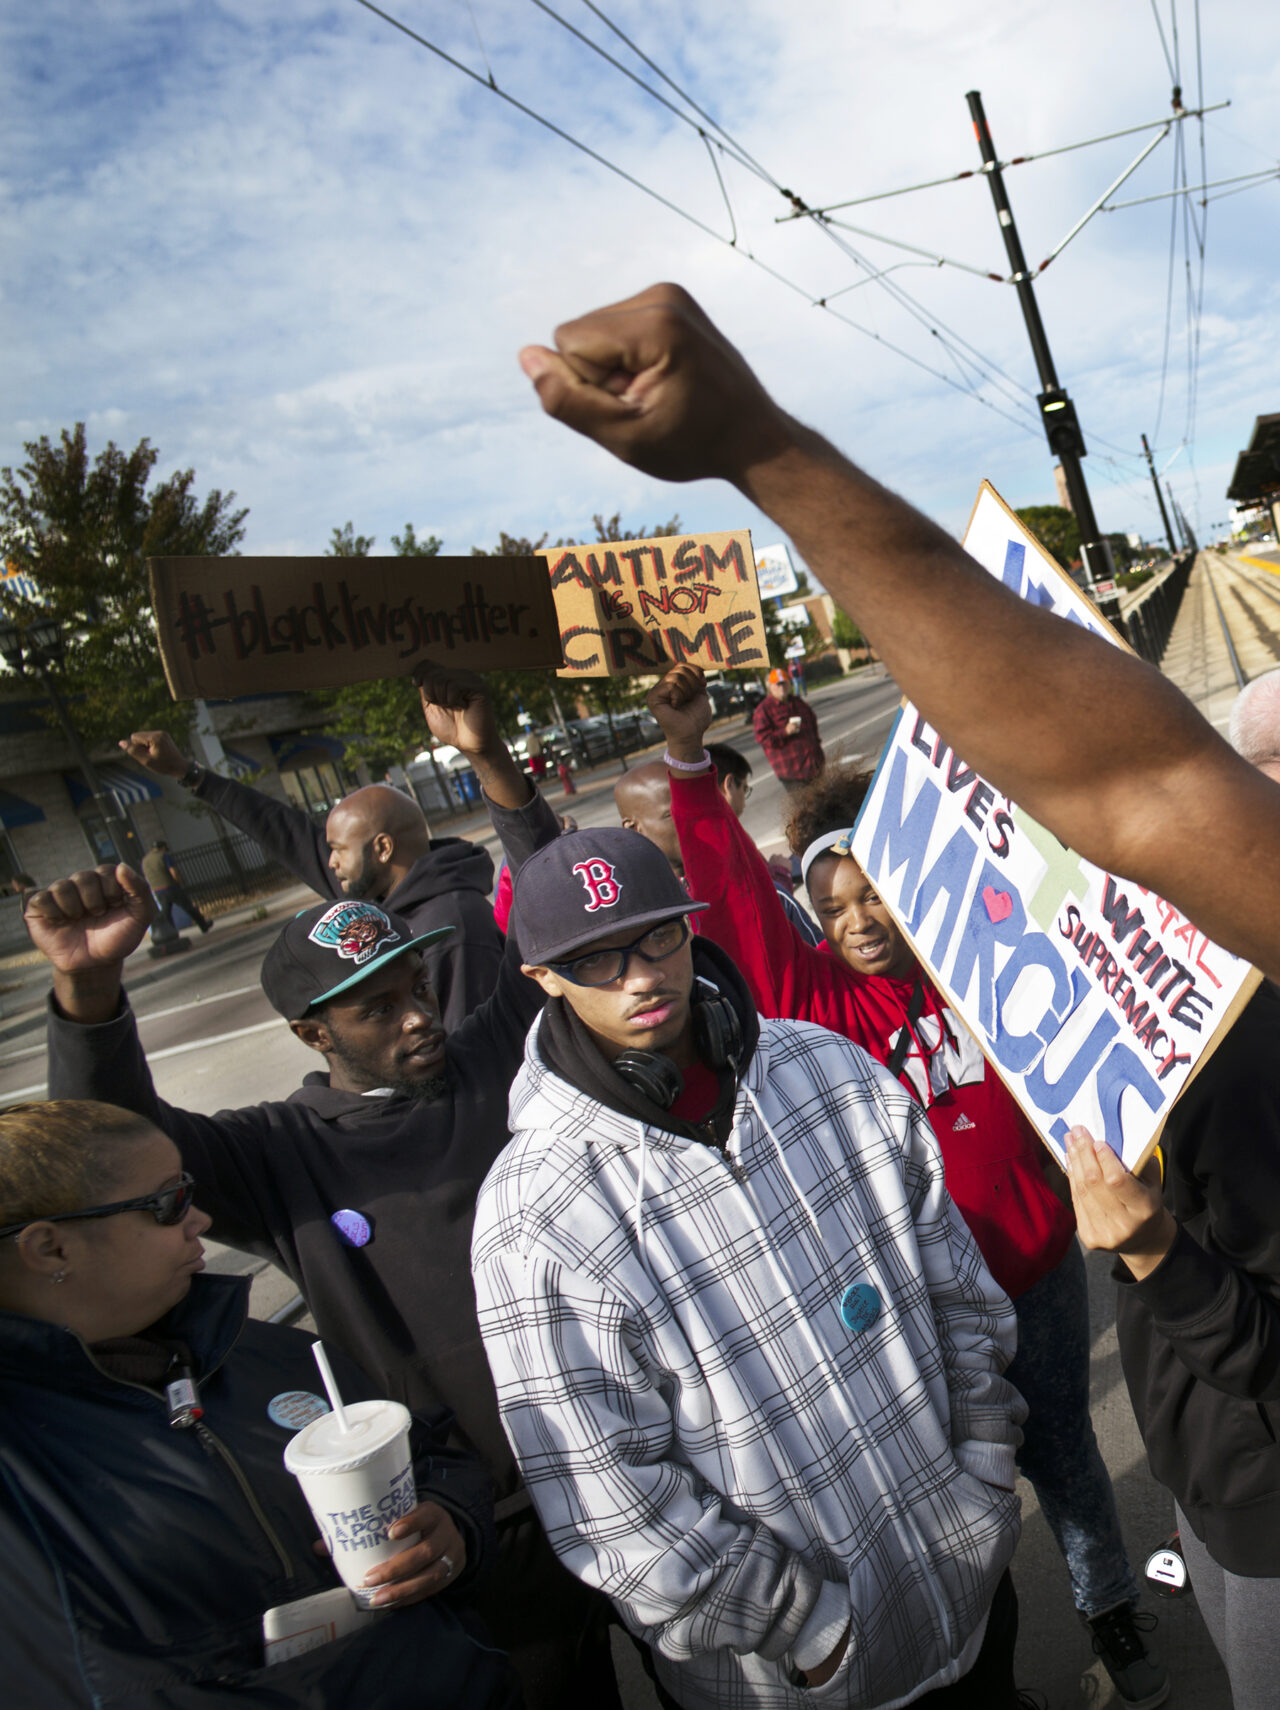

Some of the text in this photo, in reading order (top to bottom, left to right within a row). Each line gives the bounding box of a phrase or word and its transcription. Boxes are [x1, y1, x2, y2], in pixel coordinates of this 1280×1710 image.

[550, 538, 749, 590] AUTISM
[599, 583, 722, 622] IS NOT
[645, 614, 661, 627] A
[560, 610, 763, 670] CRIME
[910, 711, 1015, 860] LIVES
[572, 857, 623, 912] B
[1100, 872, 1214, 1034] WHITE
[1058, 904, 1192, 1081] SUPREMACY
[952, 1121, 976, 1132] adidas
[327, 1504, 374, 1525] THE
[335, 1526, 348, 1539] A
[338, 1526, 389, 1551] THIN
